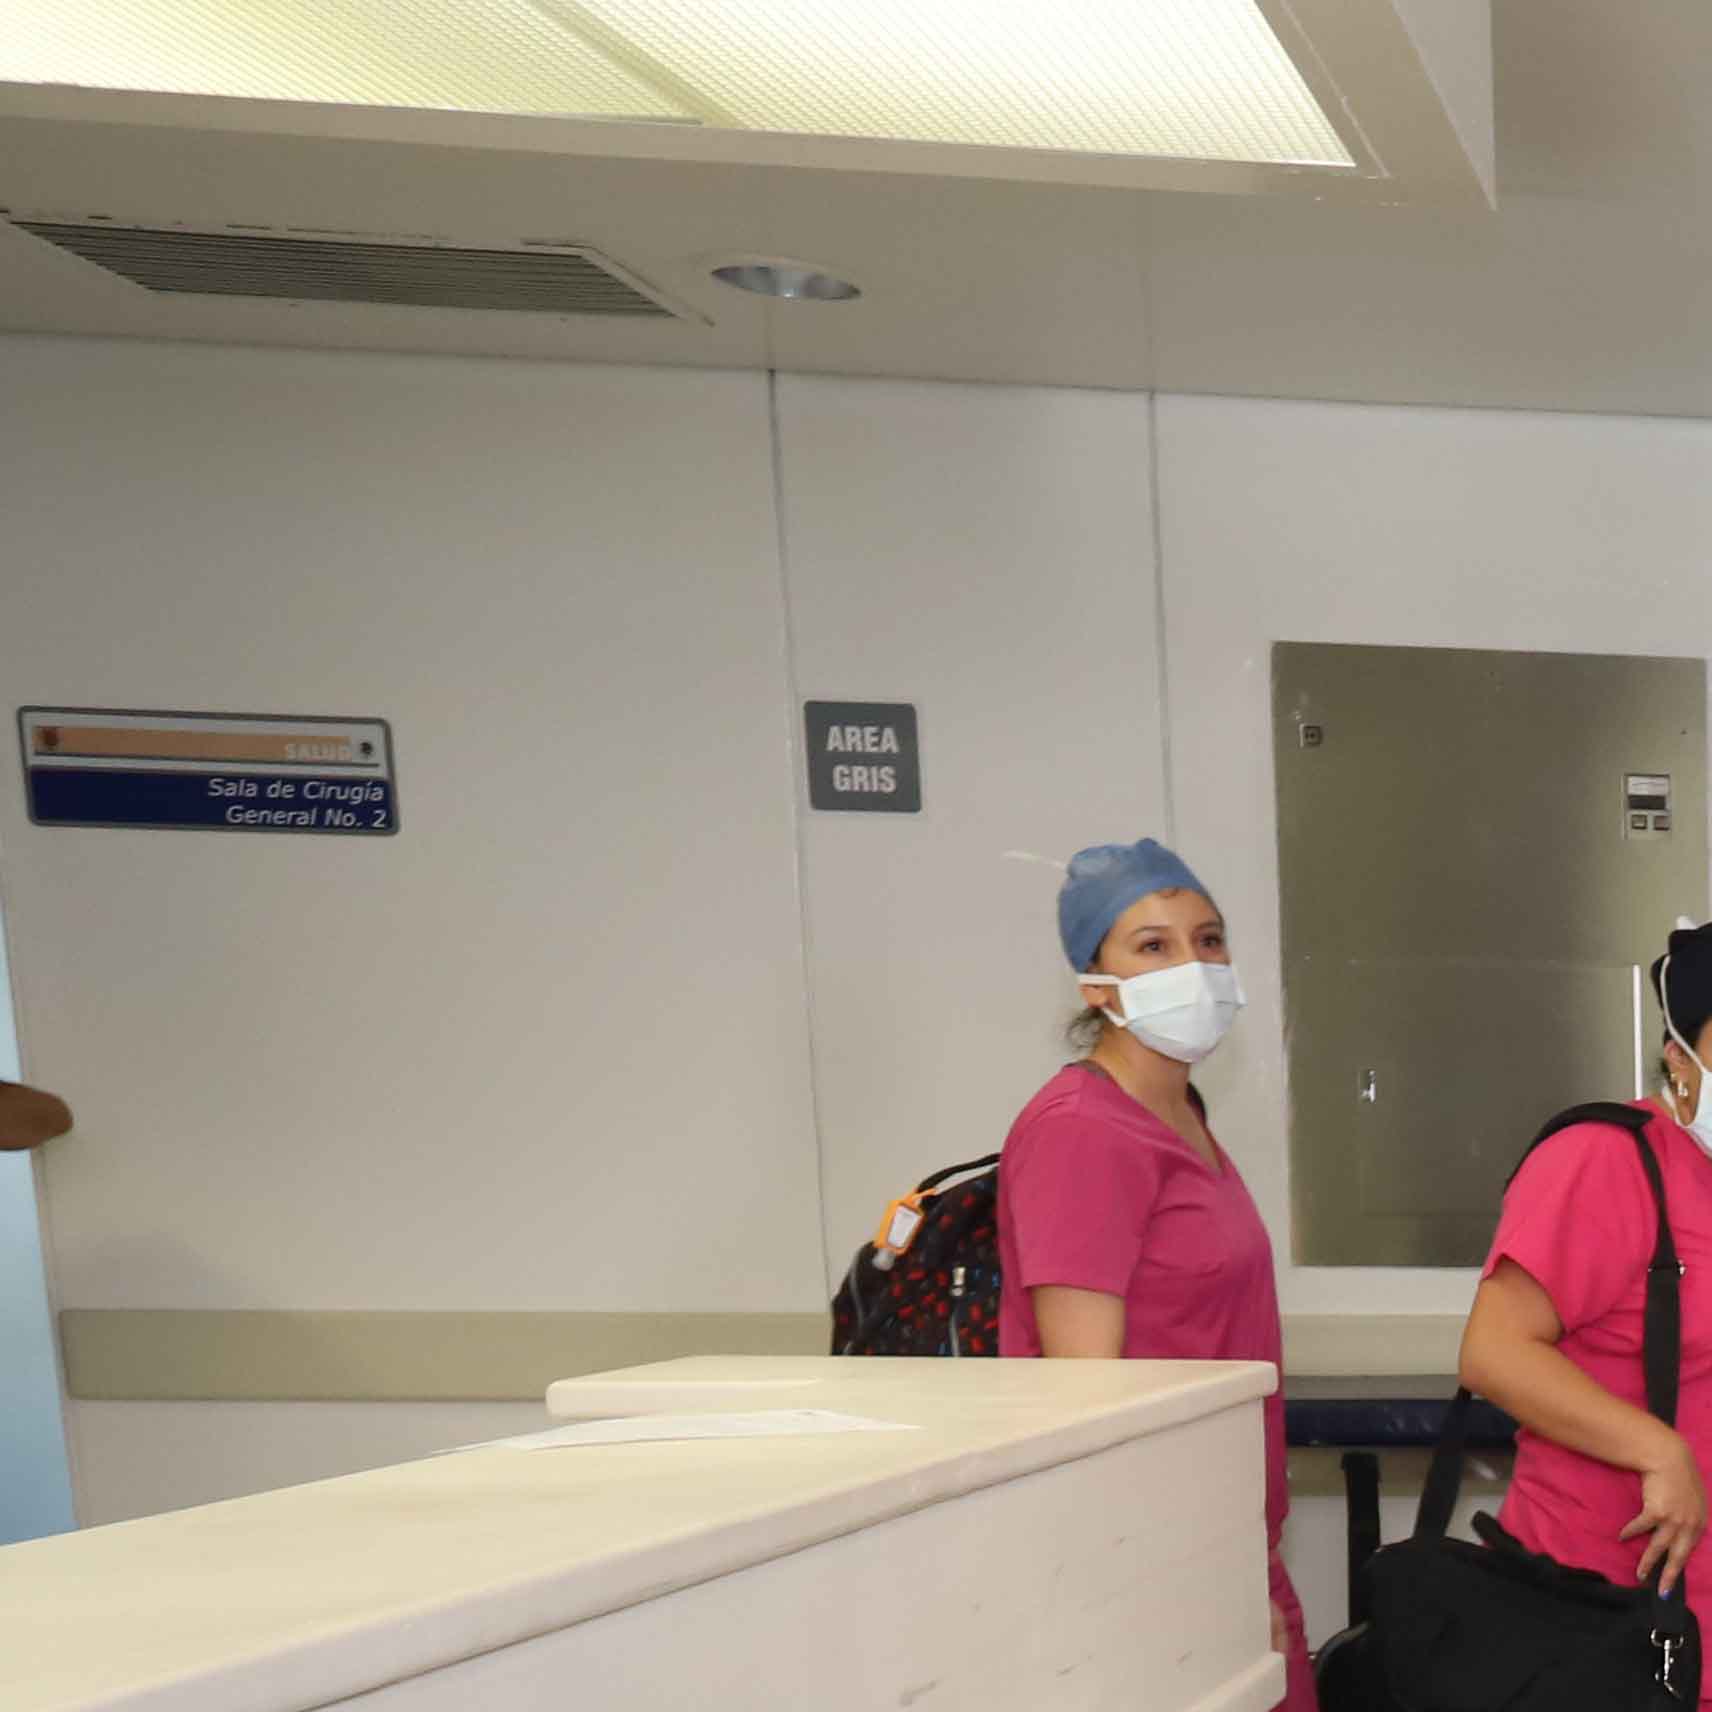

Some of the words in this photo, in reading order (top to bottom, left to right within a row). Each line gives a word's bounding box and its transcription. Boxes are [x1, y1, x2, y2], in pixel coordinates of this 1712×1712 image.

[826, 726, 900, 753] AREA
[207, 778, 258, 798] Sala
[266, 780, 295, 799] de
[303, 780, 385, 805] Cirugía
[832, 765, 897, 793] GRIS
[225, 805, 317, 826] General
[324, 809, 362, 828] No.
[371, 810, 387, 829] 2
